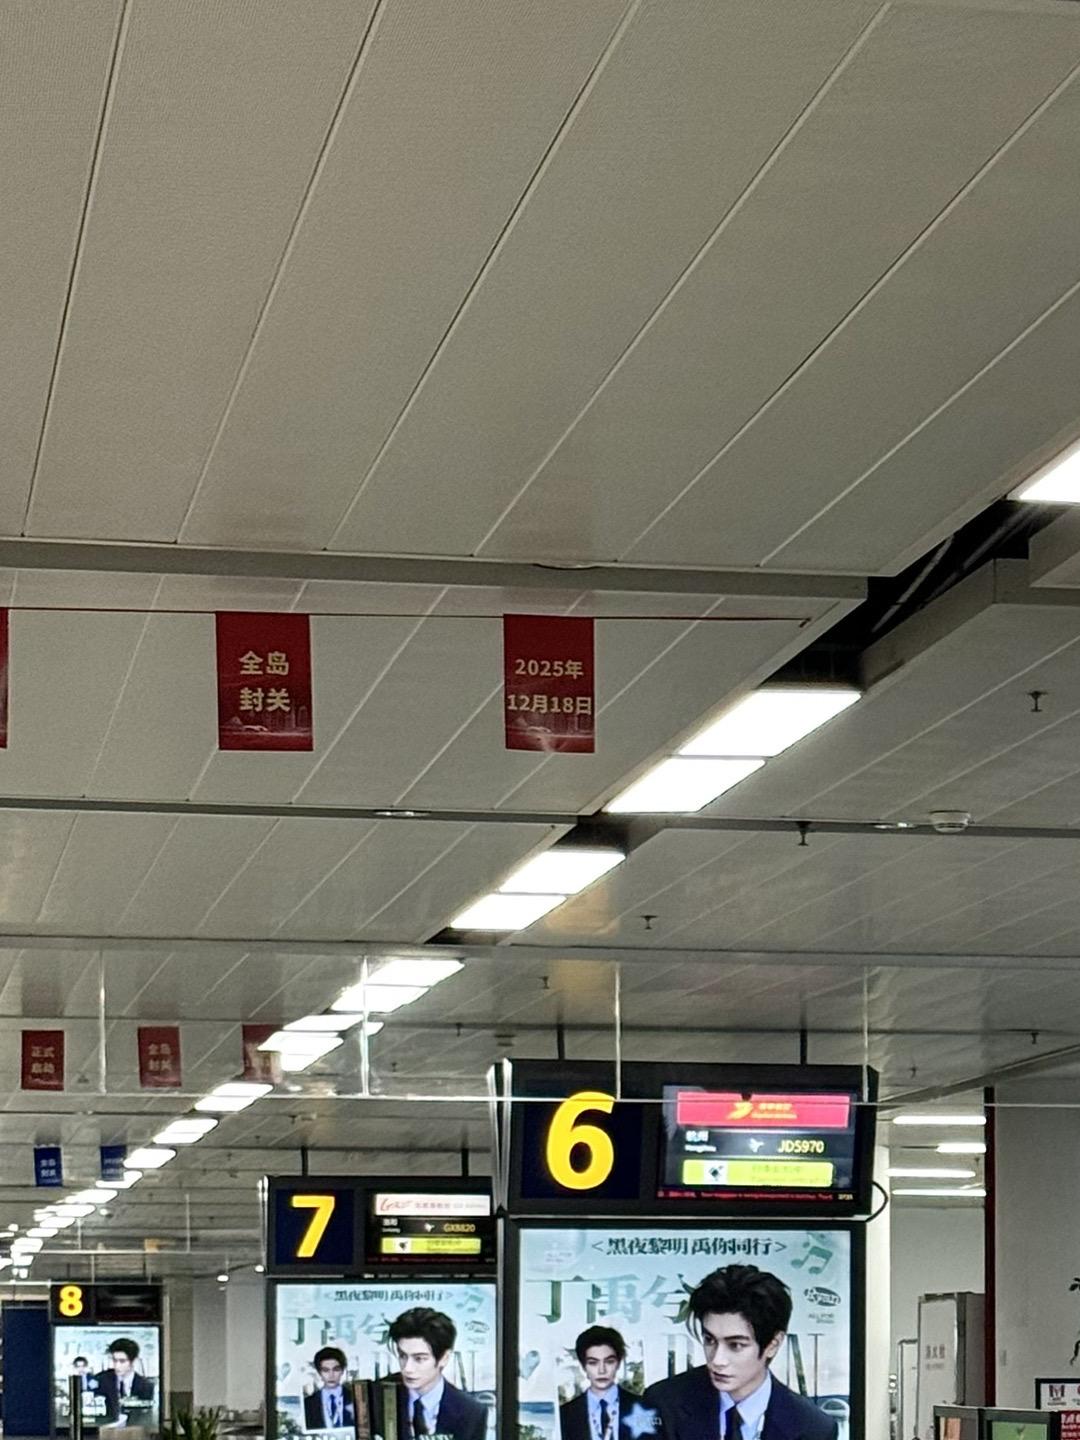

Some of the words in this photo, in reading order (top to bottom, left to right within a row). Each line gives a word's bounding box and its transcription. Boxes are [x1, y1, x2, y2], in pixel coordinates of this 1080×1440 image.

[239, 651, 290, 676] 全岛
[514, 659, 584, 679] 2025年
[239, 687, 291, 712] 封关
[507, 694, 592, 716] 12月18日
[545, 1090, 615, 1190] 6
[291, 1195, 336, 1258] 7
[59, 1285, 83, 1317] 8
